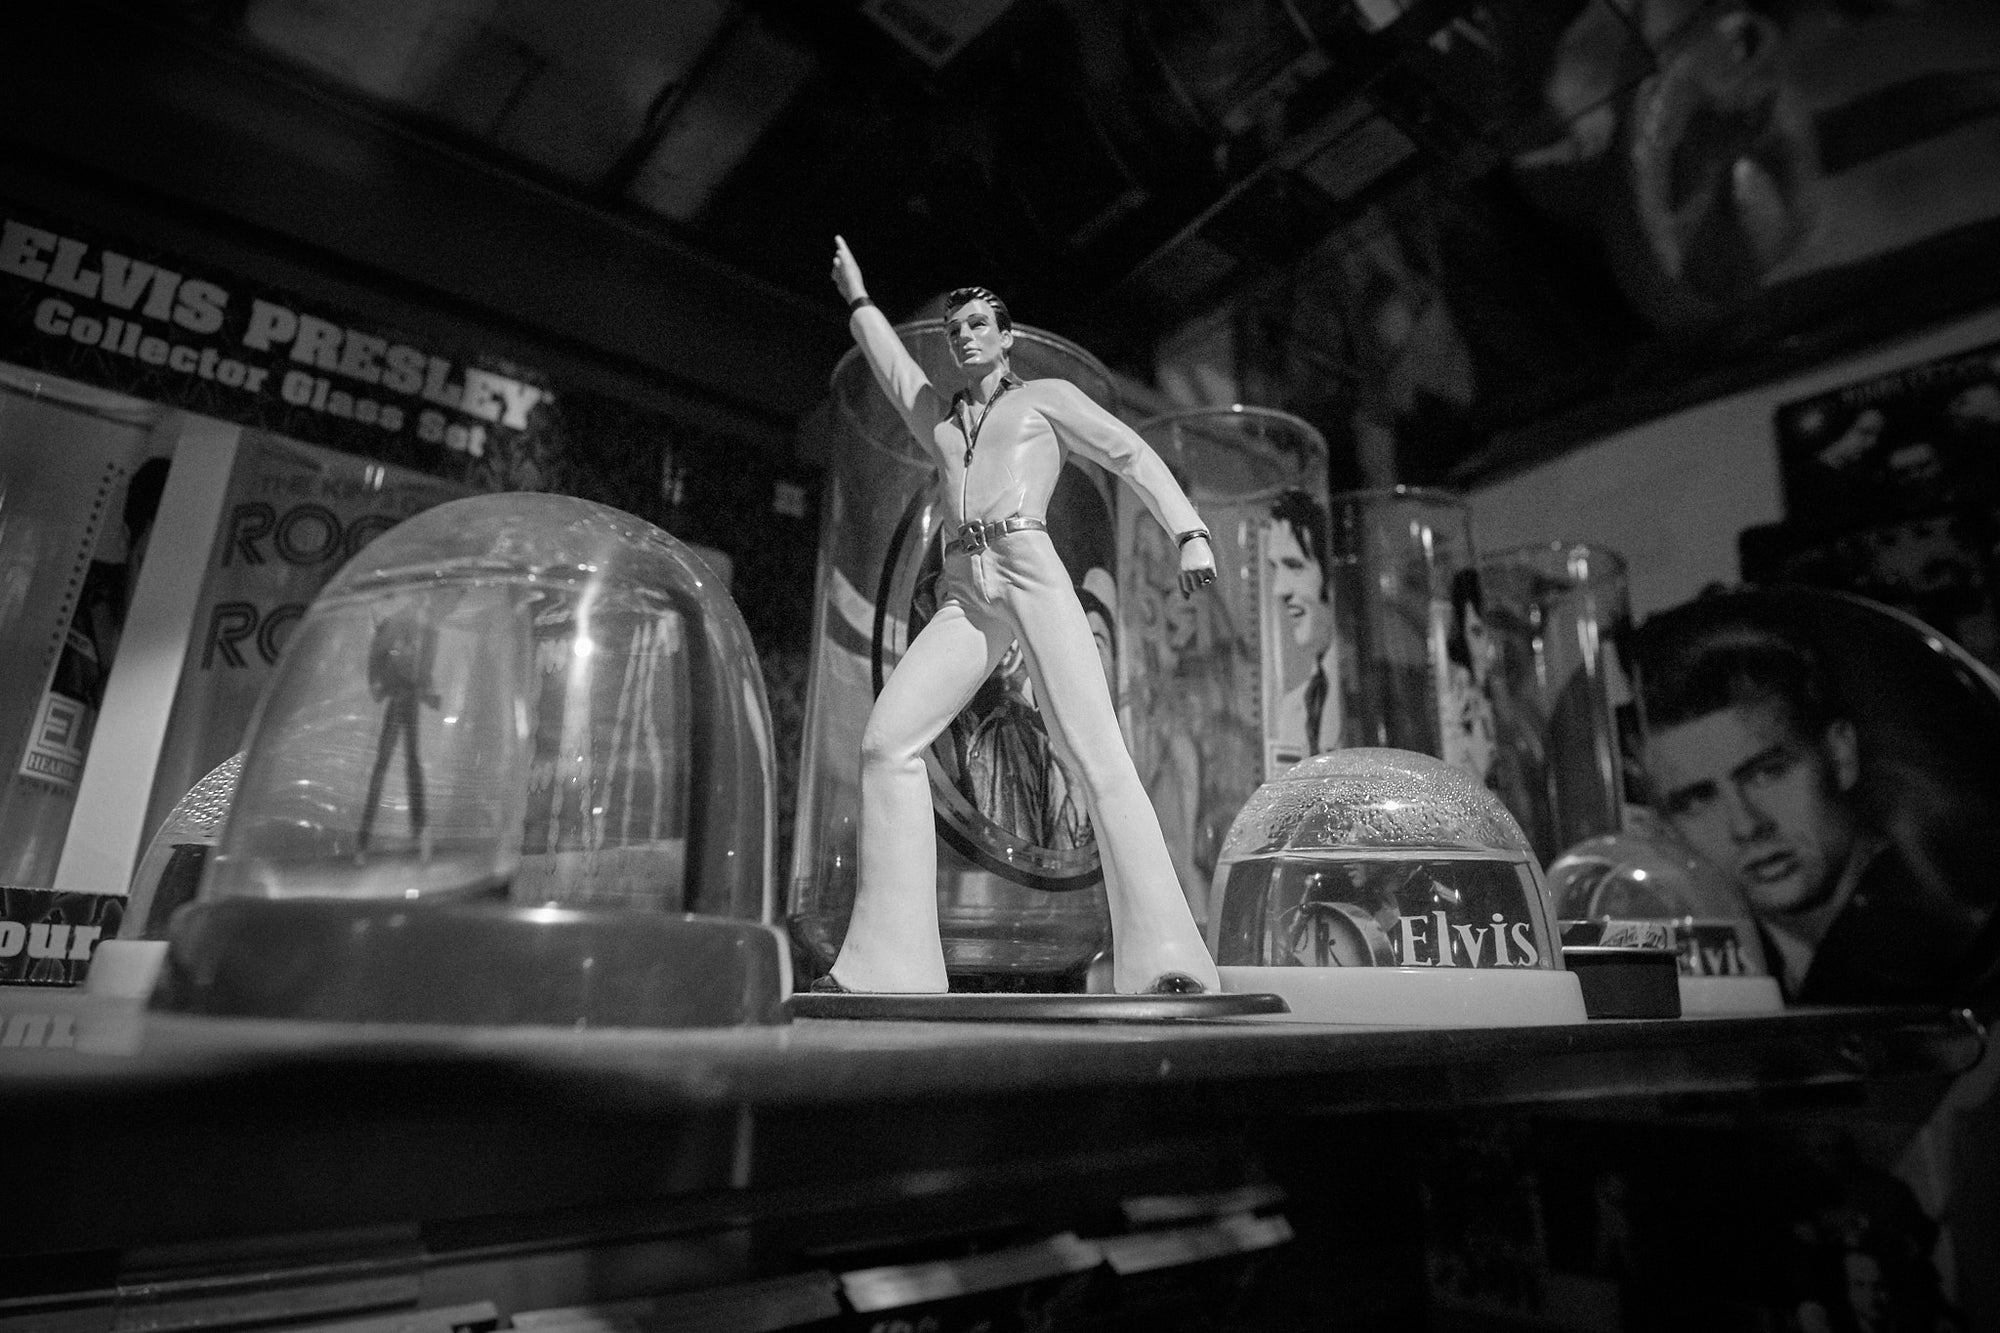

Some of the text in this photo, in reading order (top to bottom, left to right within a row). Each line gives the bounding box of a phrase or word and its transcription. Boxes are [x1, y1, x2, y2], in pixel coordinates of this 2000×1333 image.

[0, 218, 543, 431] ELVIS PRESLEY
[33, 297, 487, 457] Collector Glass Set
[1399, 910, 1539, 968] Elvis
